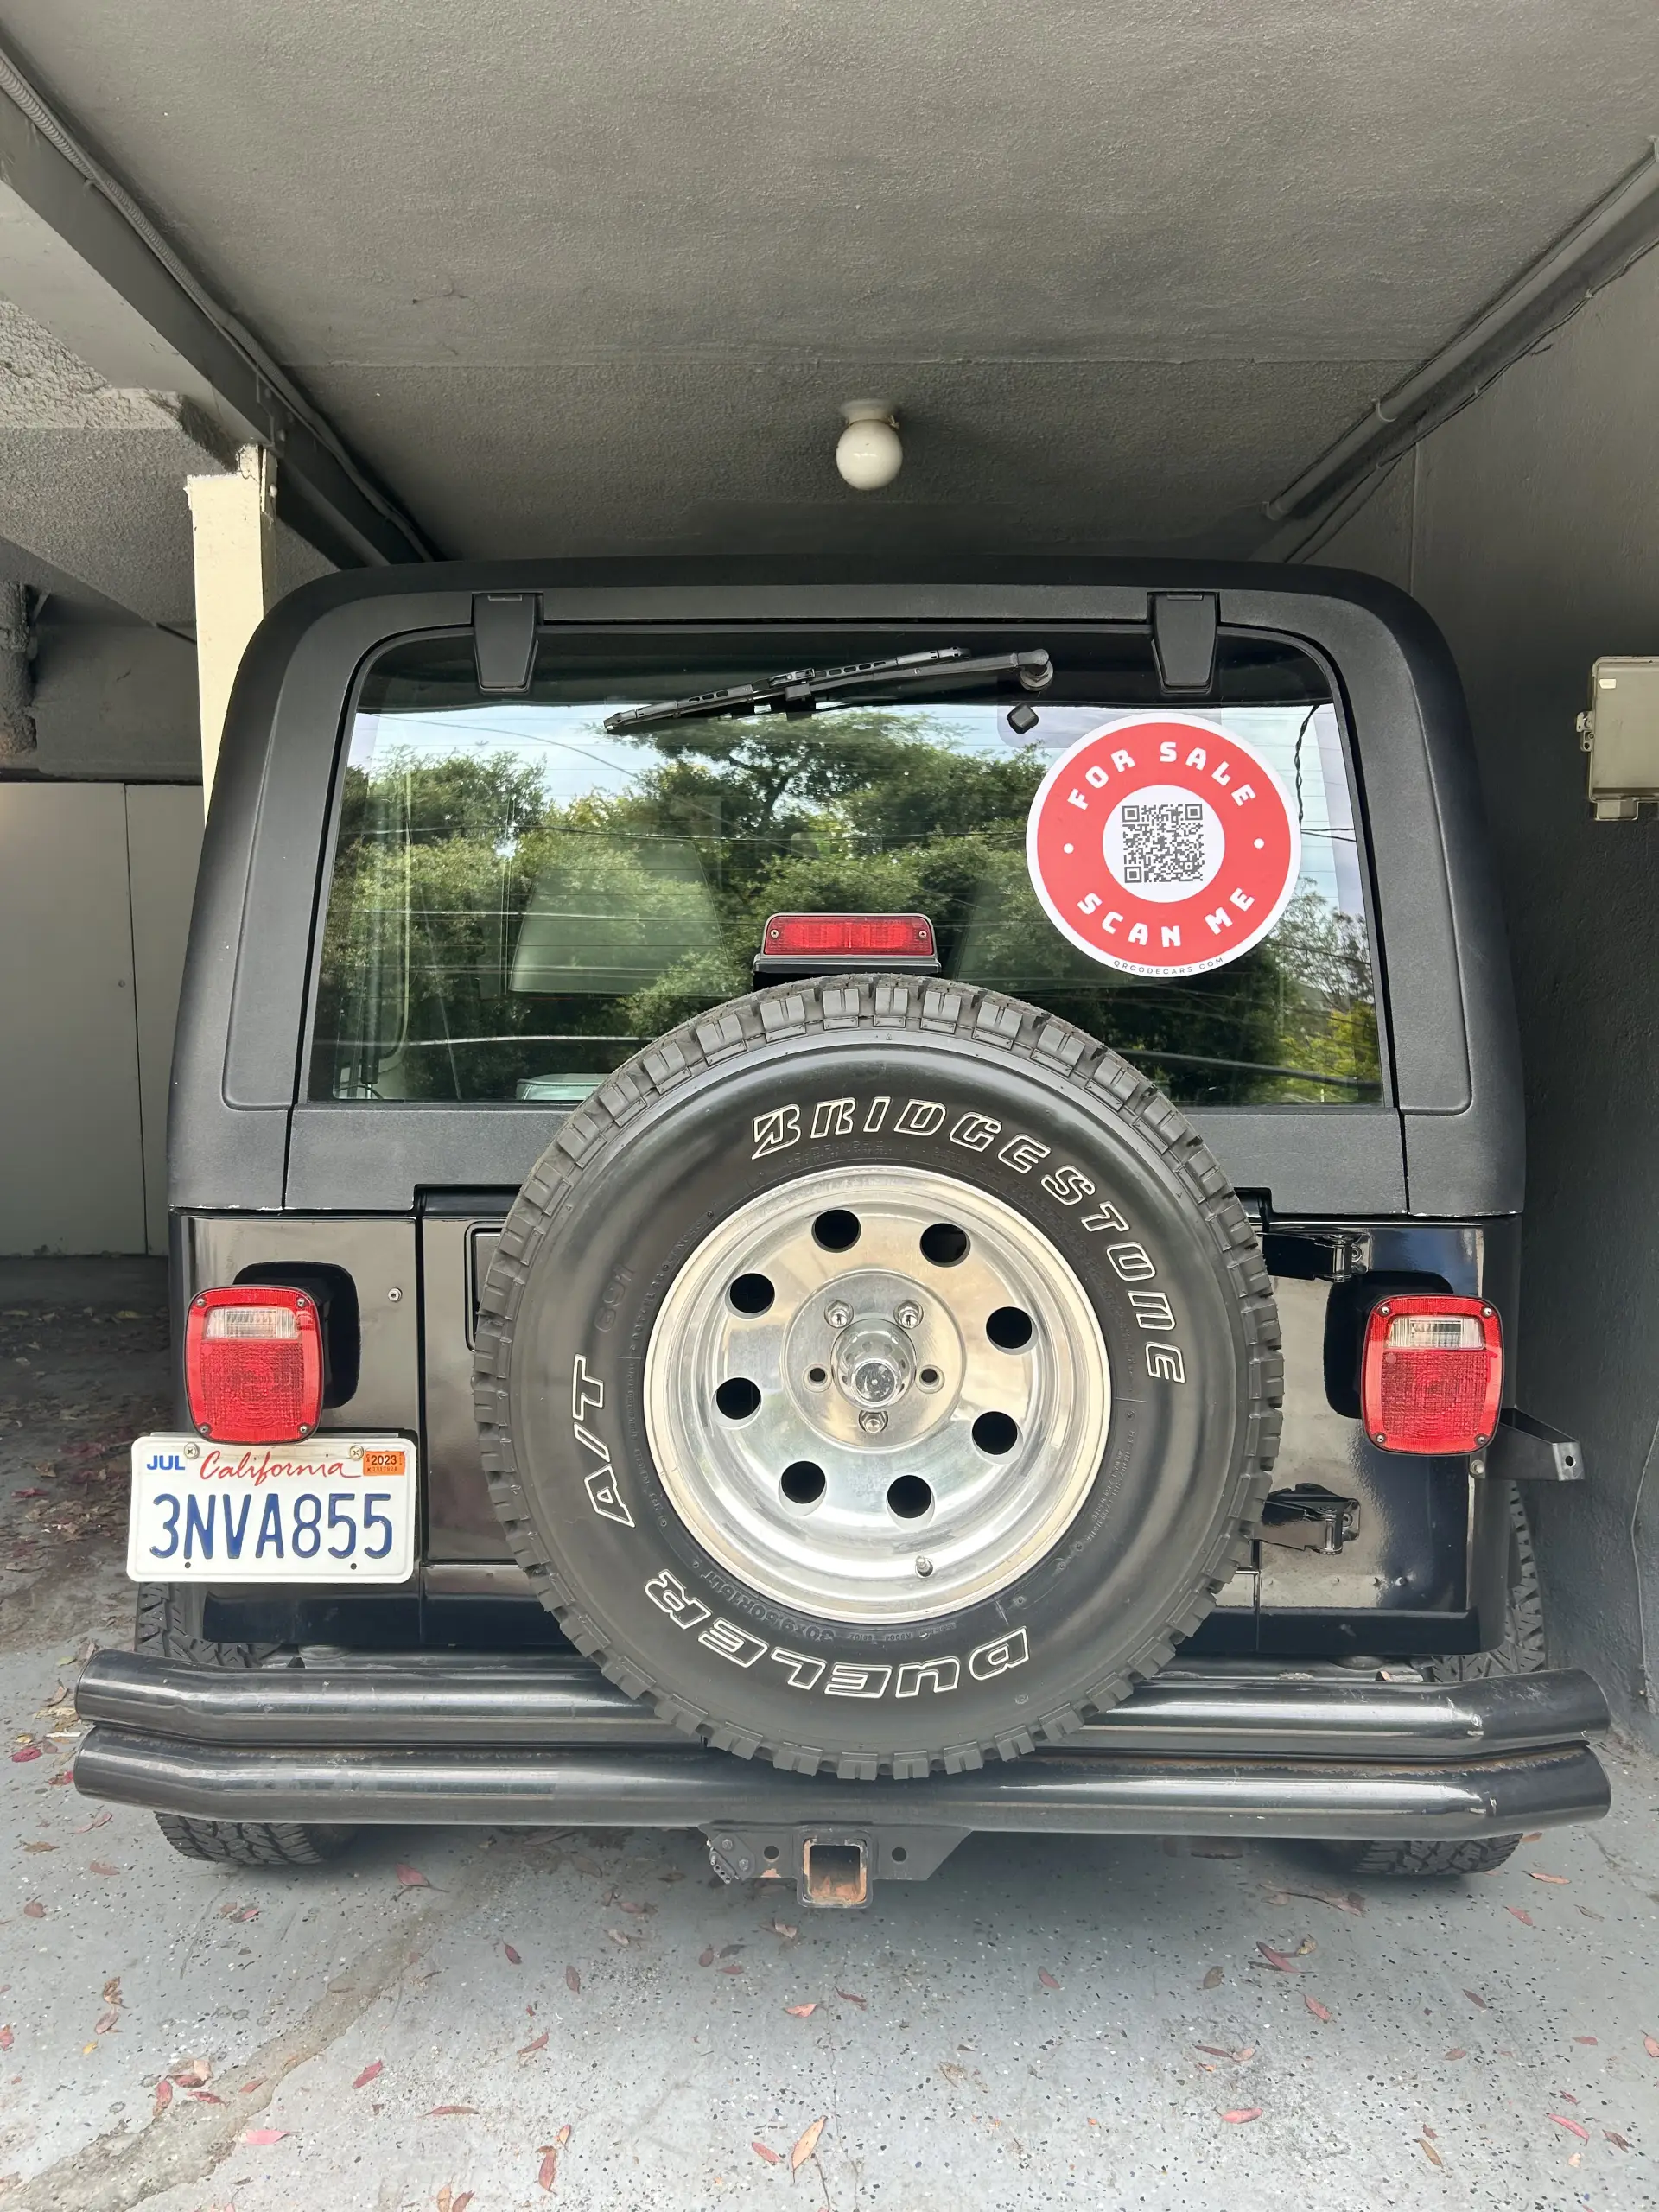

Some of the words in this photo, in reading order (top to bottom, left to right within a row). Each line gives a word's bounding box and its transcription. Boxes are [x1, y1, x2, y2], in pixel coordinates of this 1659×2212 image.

[1067, 749, 1135, 810] FOR
[1160, 741, 1256, 807] SALE
[1077, 893, 1181, 948] SCAN
[1204, 887, 1255, 936] ME
[751, 1096, 1186, 1383] BRIDGESTONE
[146, 1454, 186, 1471] JUL
[200, 1450, 361, 1486] California
[371, 1454, 397, 1465] 2023
[572, 1353, 635, 1527] A/T
[149, 1493, 393, 1560] 3NVA855
[645, 1569, 1030, 1699] DUELER
